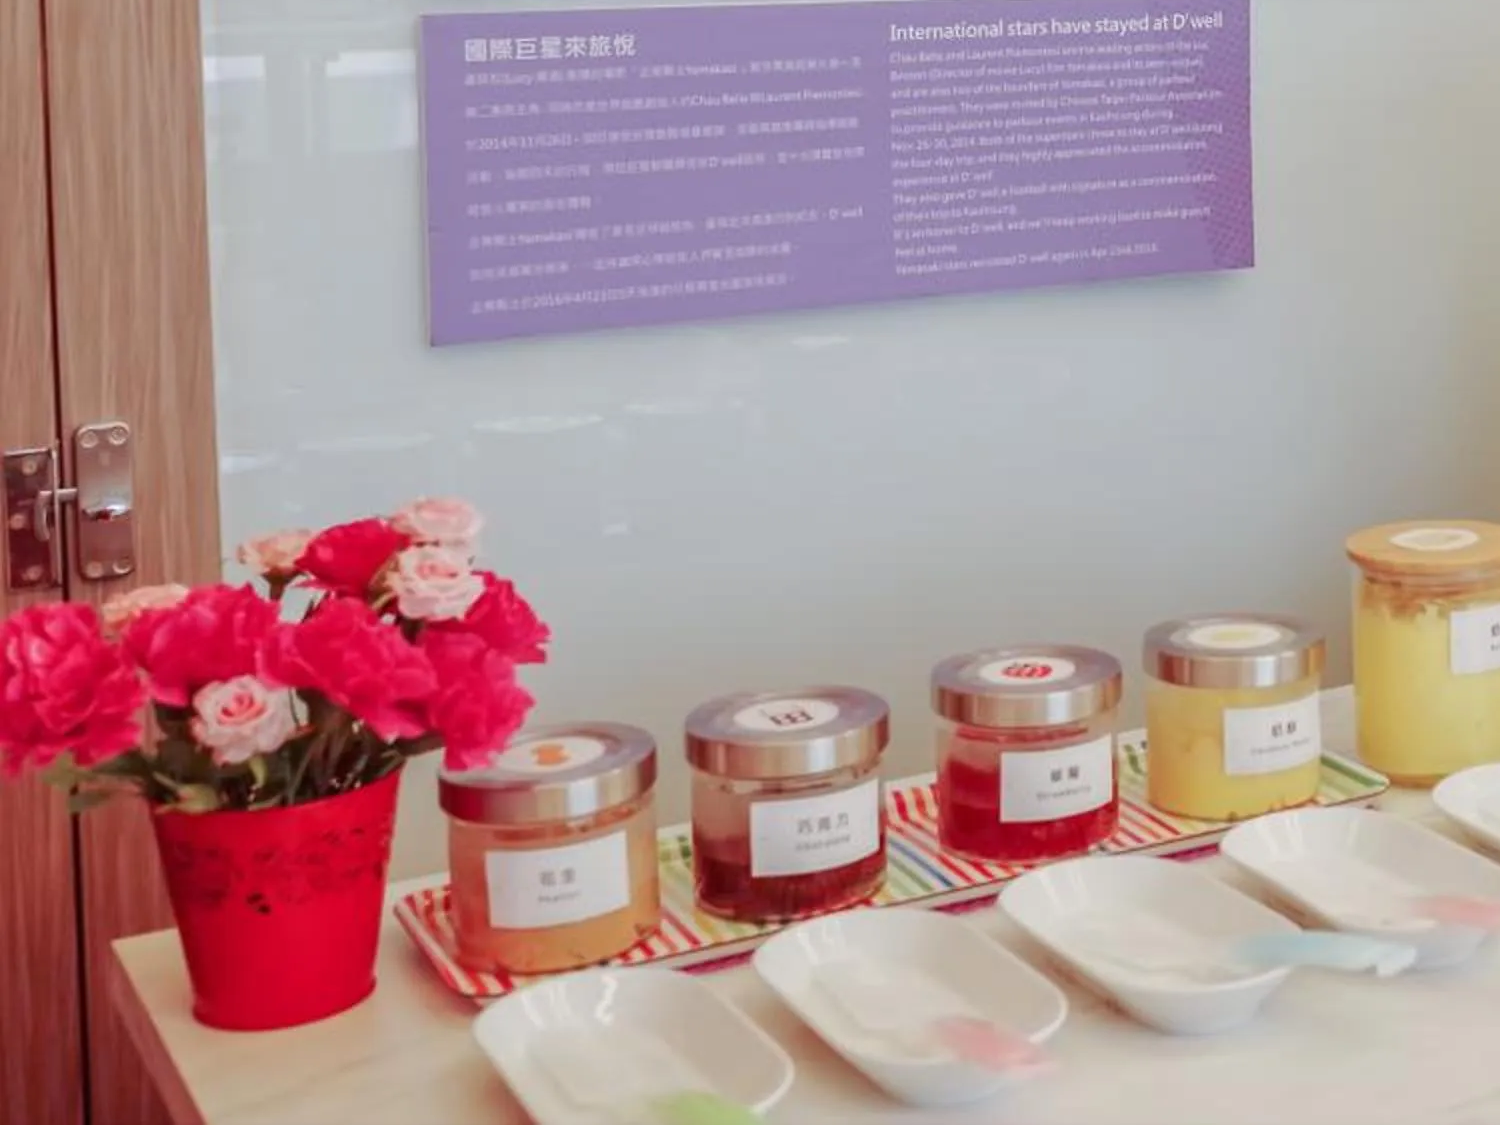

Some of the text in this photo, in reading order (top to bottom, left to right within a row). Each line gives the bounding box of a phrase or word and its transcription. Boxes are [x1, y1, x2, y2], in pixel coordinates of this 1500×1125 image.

[889, 18, 1003, 42] International
[1007, 19, 1047, 38] stars
[1051, 17, 1091, 35] have
[1094, 11, 1149, 37] stayed
[1152, 15, 1170, 32] at
[465, 33, 637, 63] 國際巨星來旅悅
